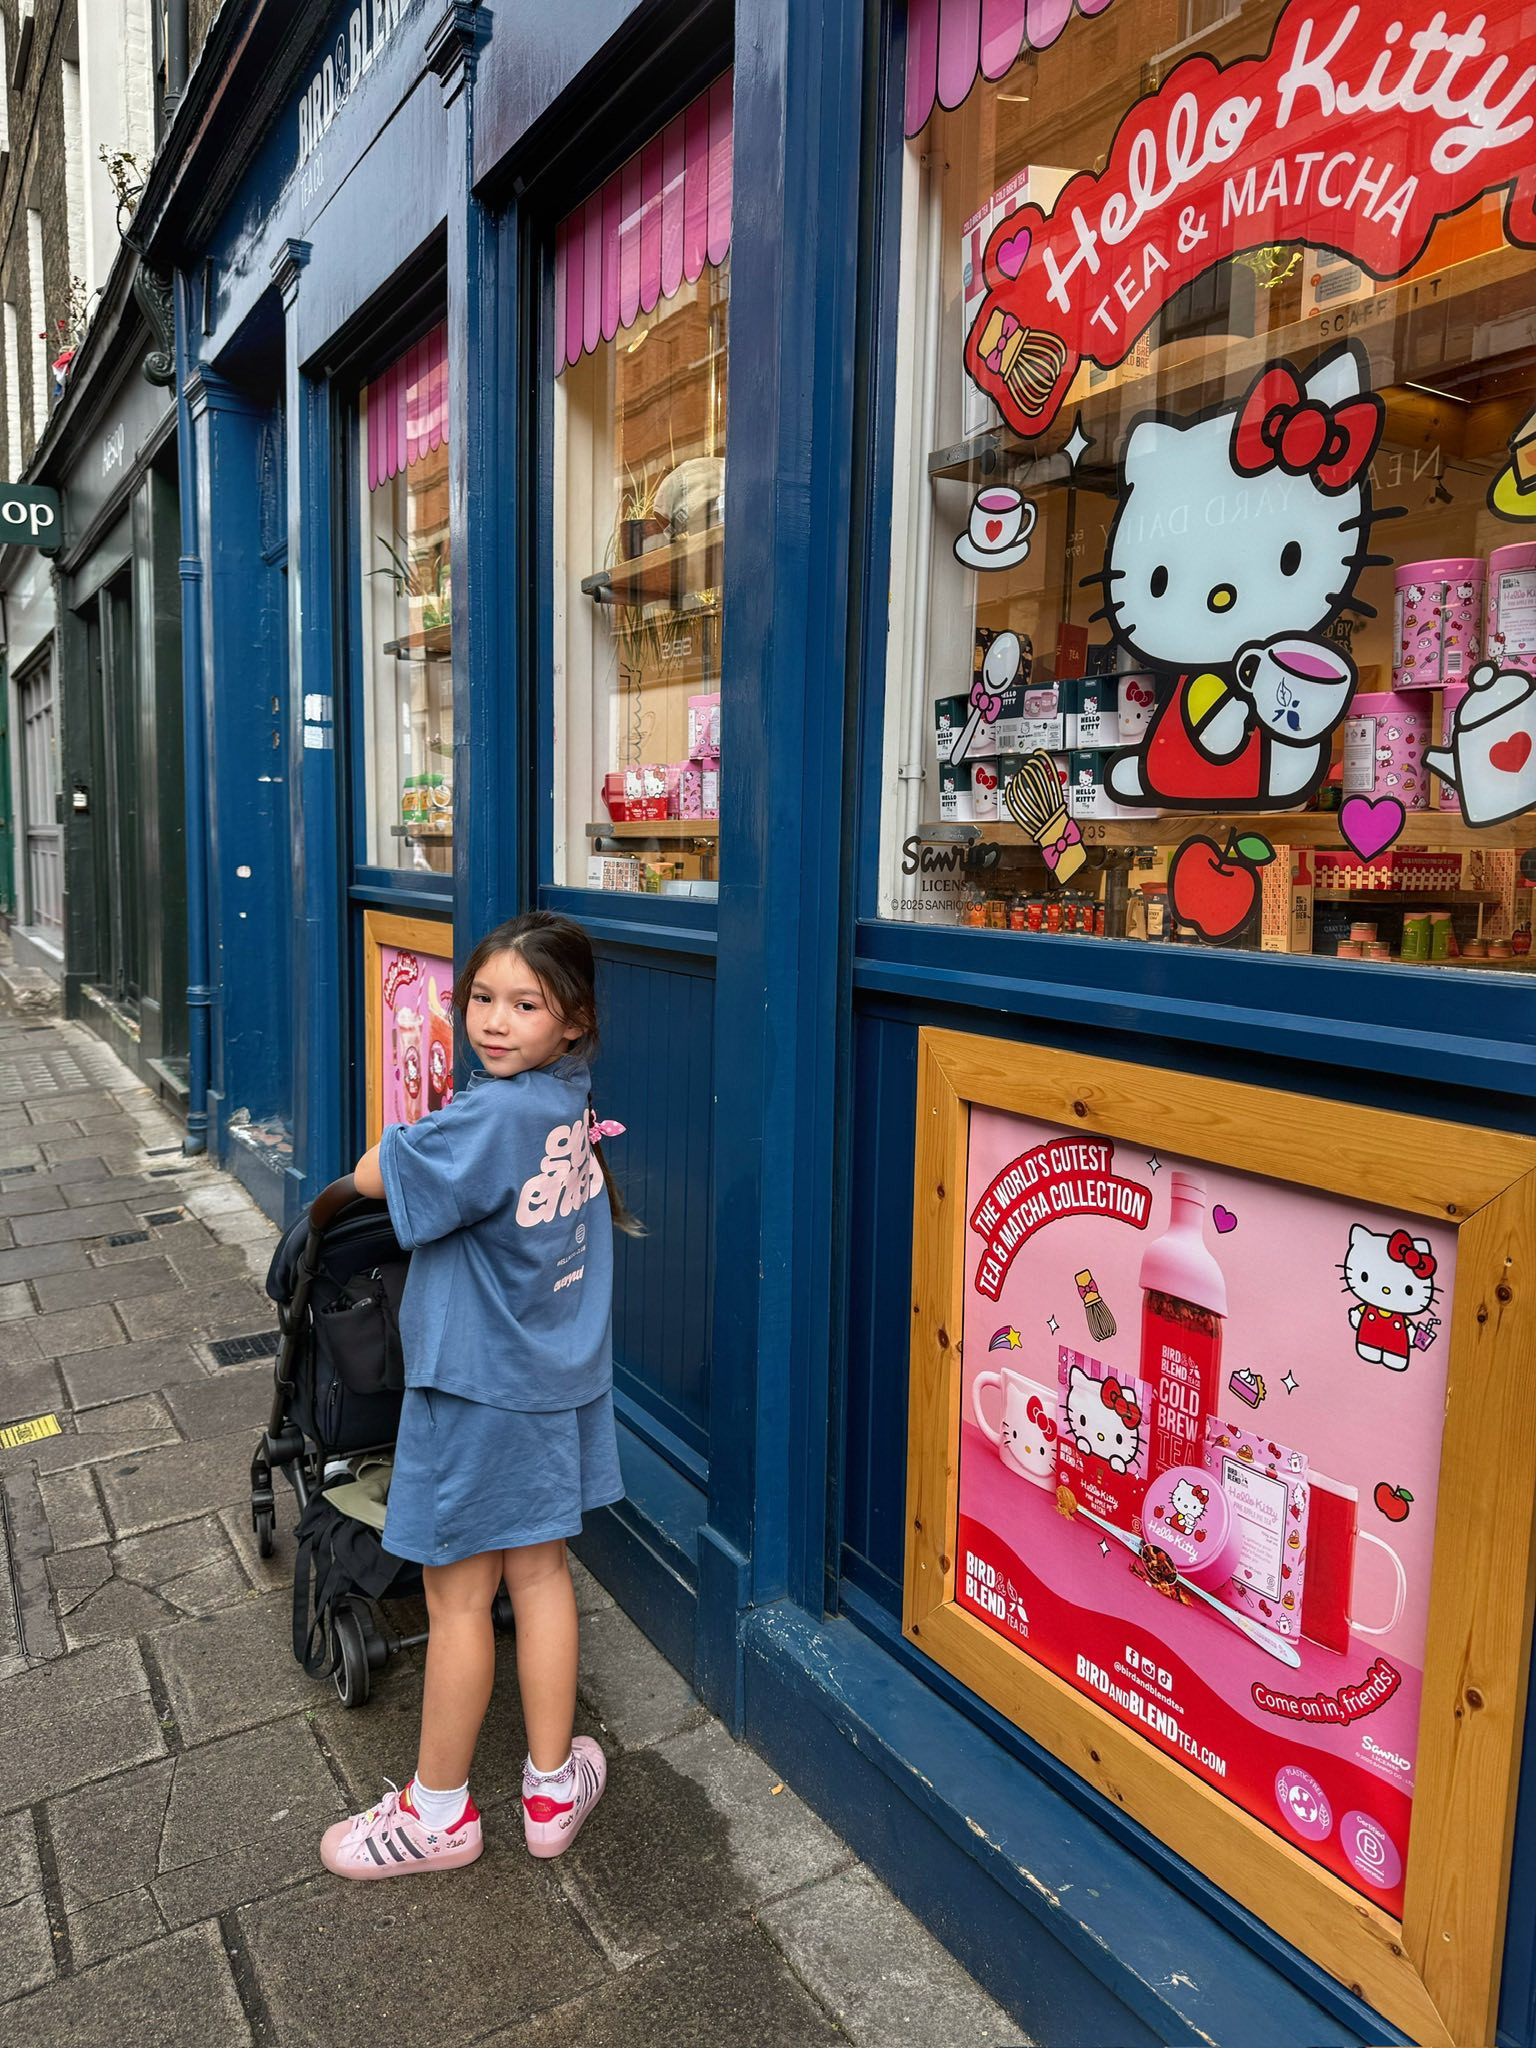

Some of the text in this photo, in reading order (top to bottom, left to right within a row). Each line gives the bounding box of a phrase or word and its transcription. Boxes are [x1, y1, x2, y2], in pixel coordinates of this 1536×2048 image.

[299, 55, 334, 170] BIRD
[335, 33, 350, 112] &
[1042, 5, 1536, 314] Hello Kitty
[301, 168, 313, 210] TEA
[1089, 151, 1419, 336] TEA & MATCHA
[2, 501, 54, 535] op
[1001, 690, 1017, 698] ELLO
[1080, 723, 1100, 731] KITTY
[902, 836, 1000, 875] Sanrio
[922, 879, 974, 892] LICENS
[900, 900, 924, 911] 2025
[925, 900, 963, 911] SANRIO
[975, 1144, 1108, 1236] THE WORLD'S CUTEST
[979, 1180, 1146, 1294] TEA & MATCHA COLLECTION
[1161, 1357, 1187, 1381] BLEND
[1162, 1345, 1181, 1364] BIRD
[1160, 1377, 1200, 1417] COLD
[1158, 1403, 1198, 1443] BREW
[1158, 1428, 1195, 1468] TEA
[1081, 1479, 1118, 1510] Hello Kitty
[1228, 1486, 1279, 1524] Hello Kitty
[1148, 1520, 1174, 1543] Hello
[1174, 1536, 1199, 1564] Kitty
[966, 1550, 996, 1589] BIRD
[966, 1573, 1030, 1639] BLEND TEA CO.
[1114, 1661, 1185, 1715] @birdandblendtea
[1255, 1663, 1396, 1719] Come on in, friends!
[1076, 1653, 1227, 1778] BIRDANDBLENDTEA.COM
[1361, 1735, 1411, 1771] Sanrio
[1371, 1754, 1400, 1773] LICENSE
[1285, 1768, 1323, 1797] PLASTIC-FREE
[1356, 1815, 1386, 1840] Certified
